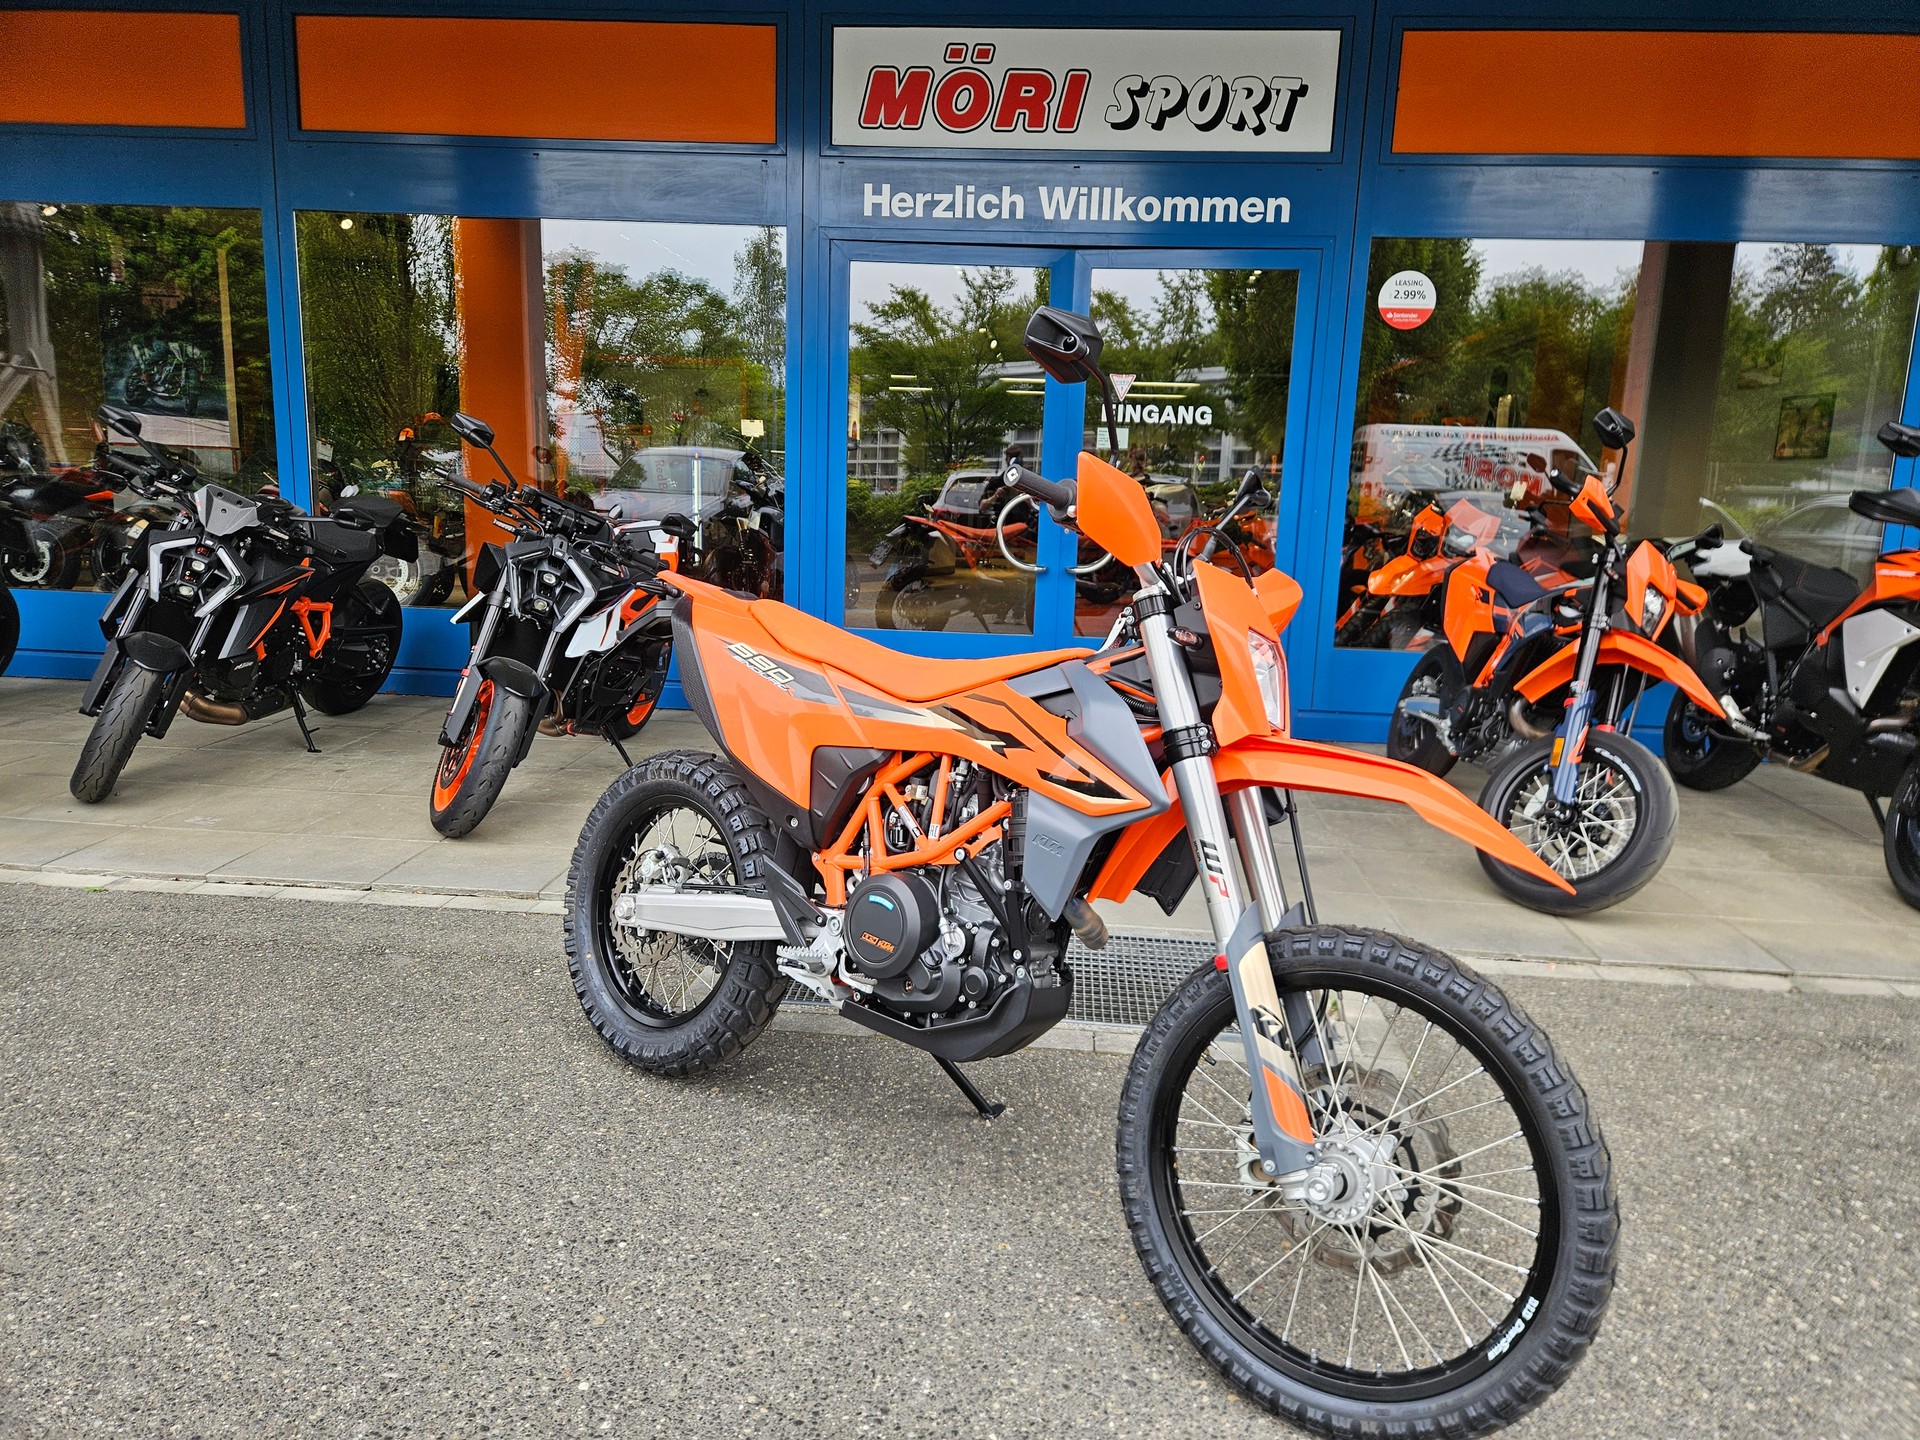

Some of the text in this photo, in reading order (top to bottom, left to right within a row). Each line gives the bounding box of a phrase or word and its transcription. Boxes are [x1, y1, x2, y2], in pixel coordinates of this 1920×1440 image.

[858, 43, 1309, 136] MÖRI SPORT
[862, 182, 1291, 224] Herzlich Willkommen
[1393, 290, 1427, 300] 2.99%
[727, 642, 795, 685] 690
[1032, 833, 1065, 858] KTM
